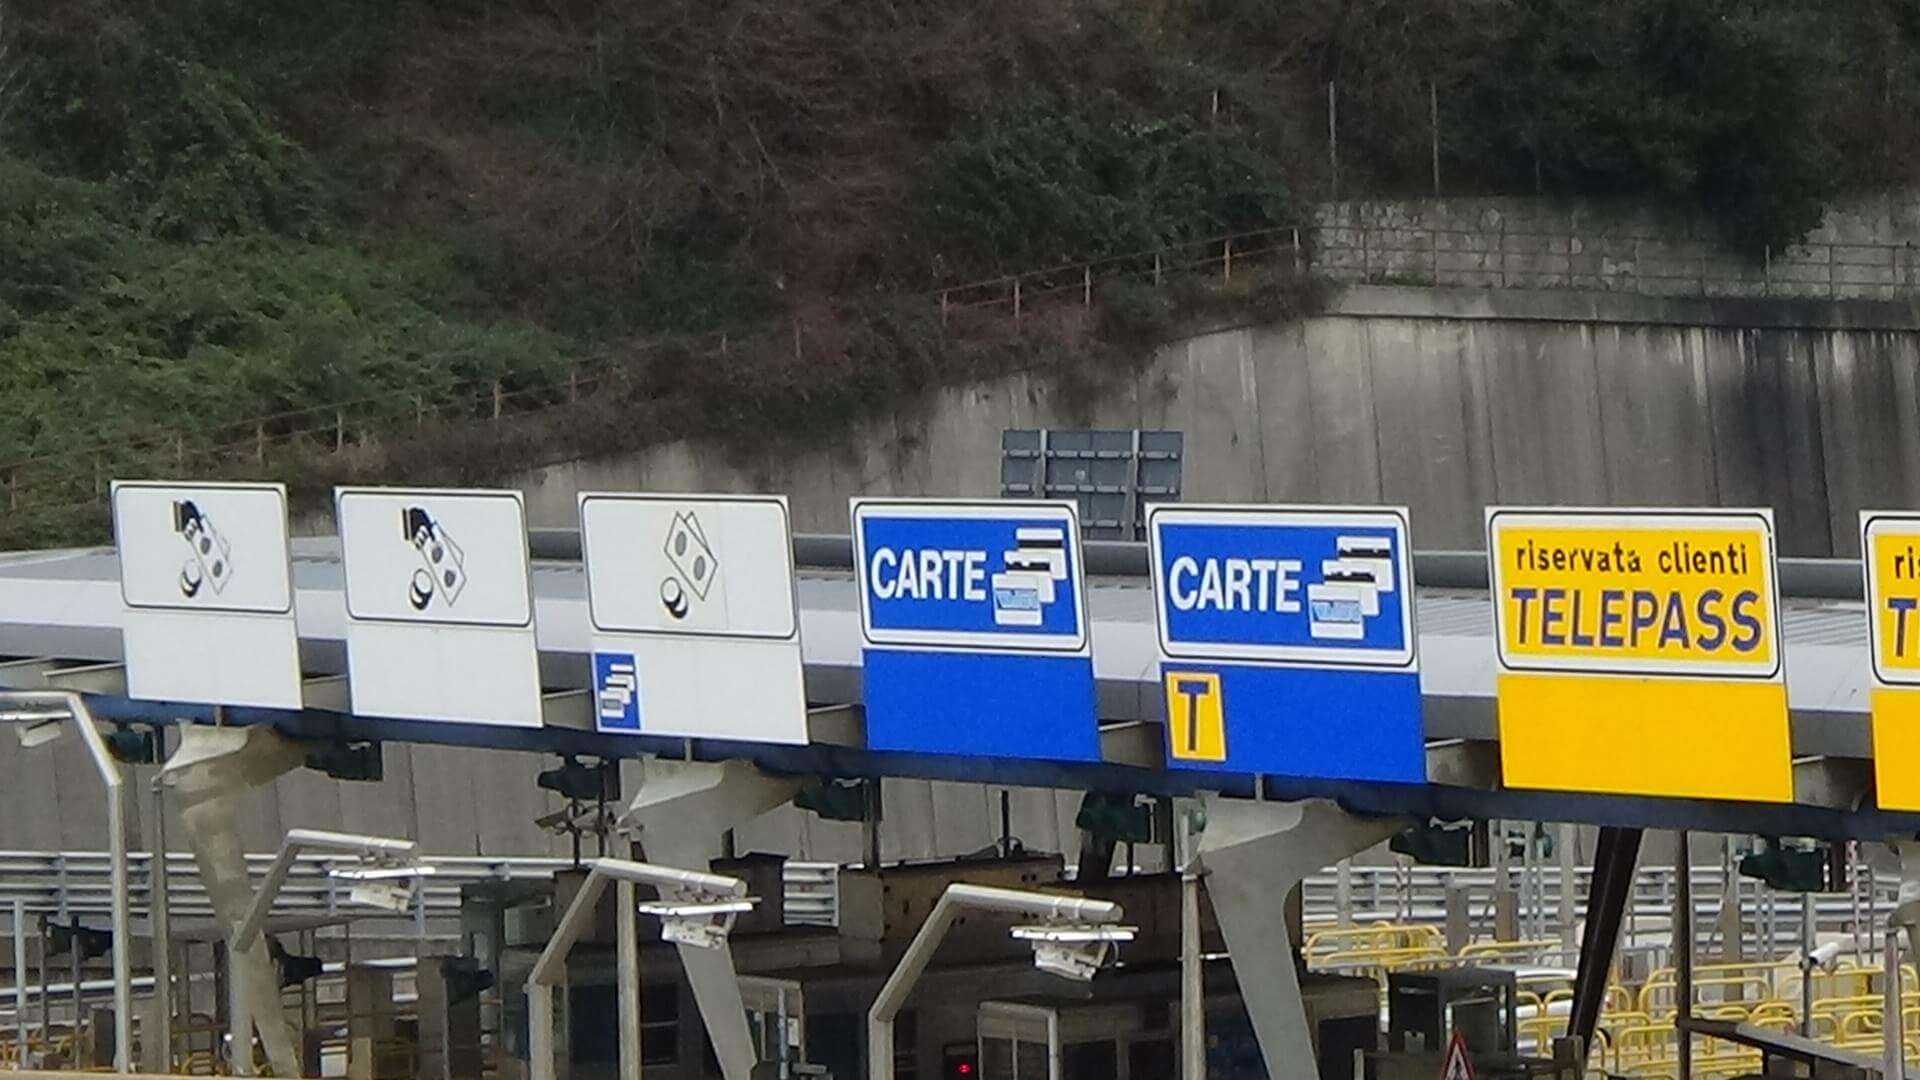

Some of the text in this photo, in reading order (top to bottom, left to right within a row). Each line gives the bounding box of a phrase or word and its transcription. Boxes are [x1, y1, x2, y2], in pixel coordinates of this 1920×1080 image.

[870, 547, 987, 601] CARTE
[1169, 556, 1302, 614] CARTE
[1516, 540, 1748, 576] riservata clienti
[1894, 545, 1920, 580] ri
[1511, 587, 1763, 653] TELEPASS
[1178, 680, 1211, 753] T
